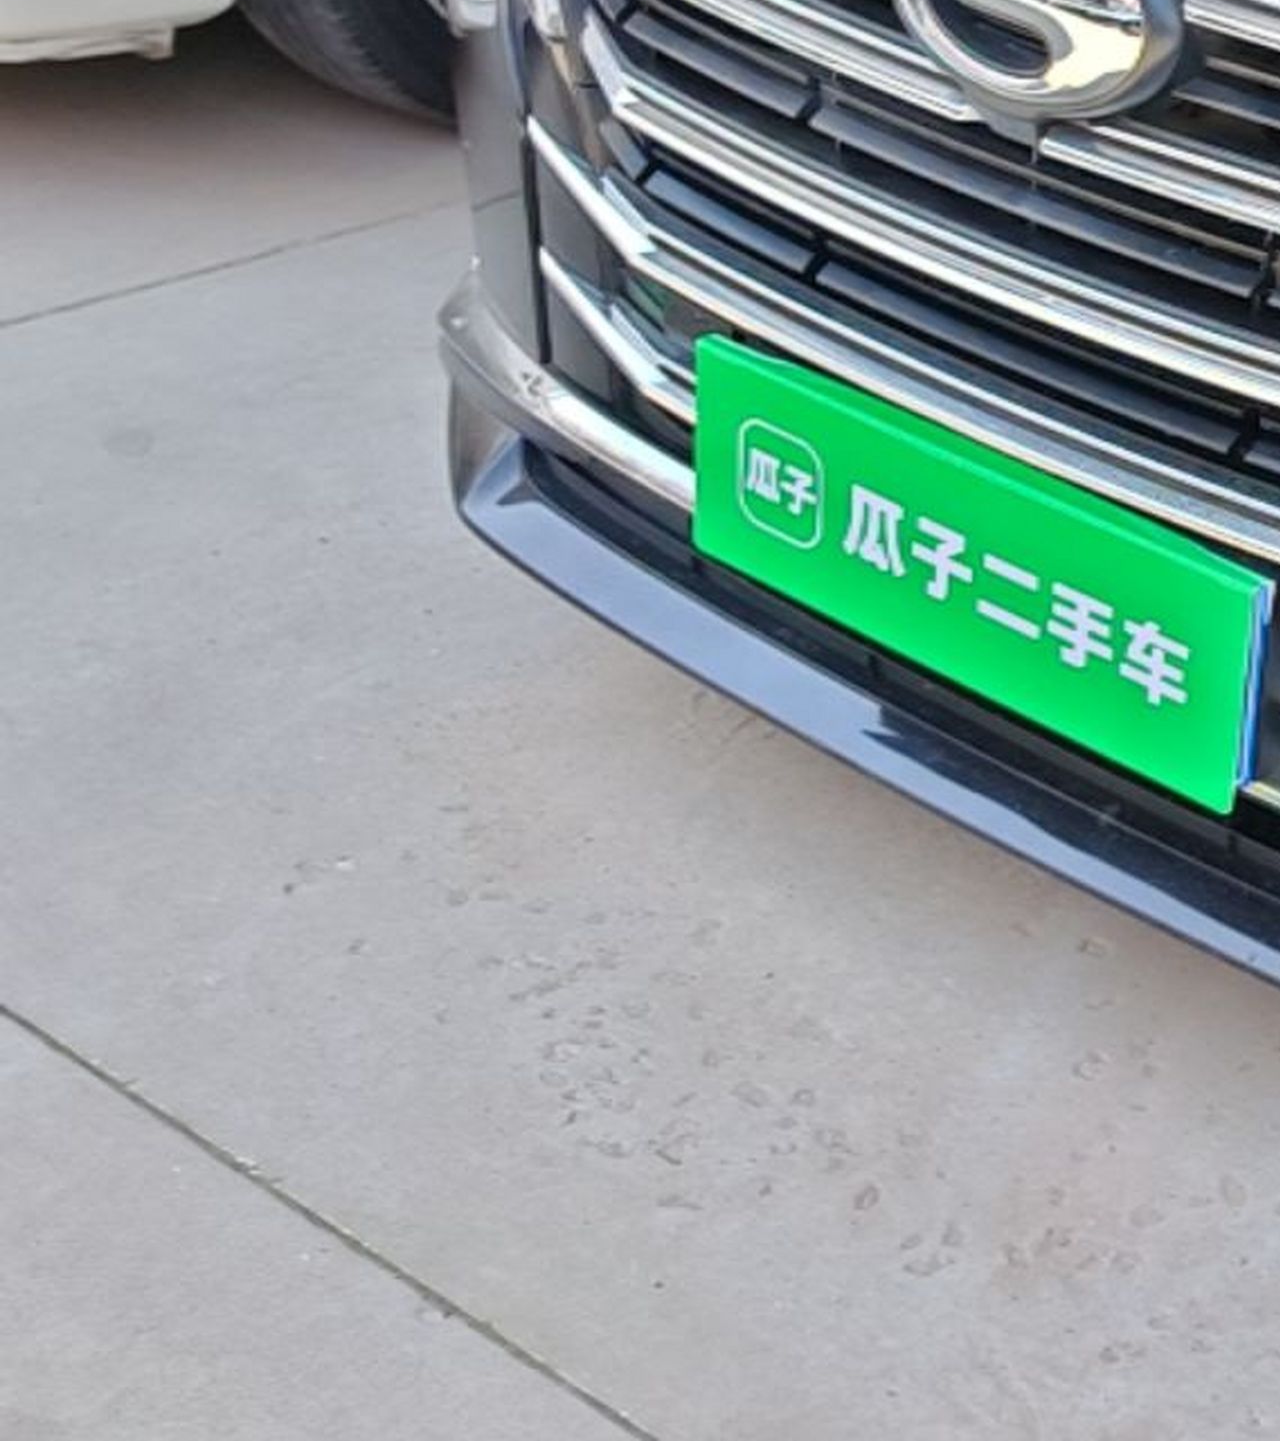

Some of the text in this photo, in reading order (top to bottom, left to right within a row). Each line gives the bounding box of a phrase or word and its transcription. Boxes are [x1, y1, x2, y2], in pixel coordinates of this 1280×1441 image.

[746, 447, 817, 516] 瓜子
[842, 484, 1190, 706] 瓜子二手车
